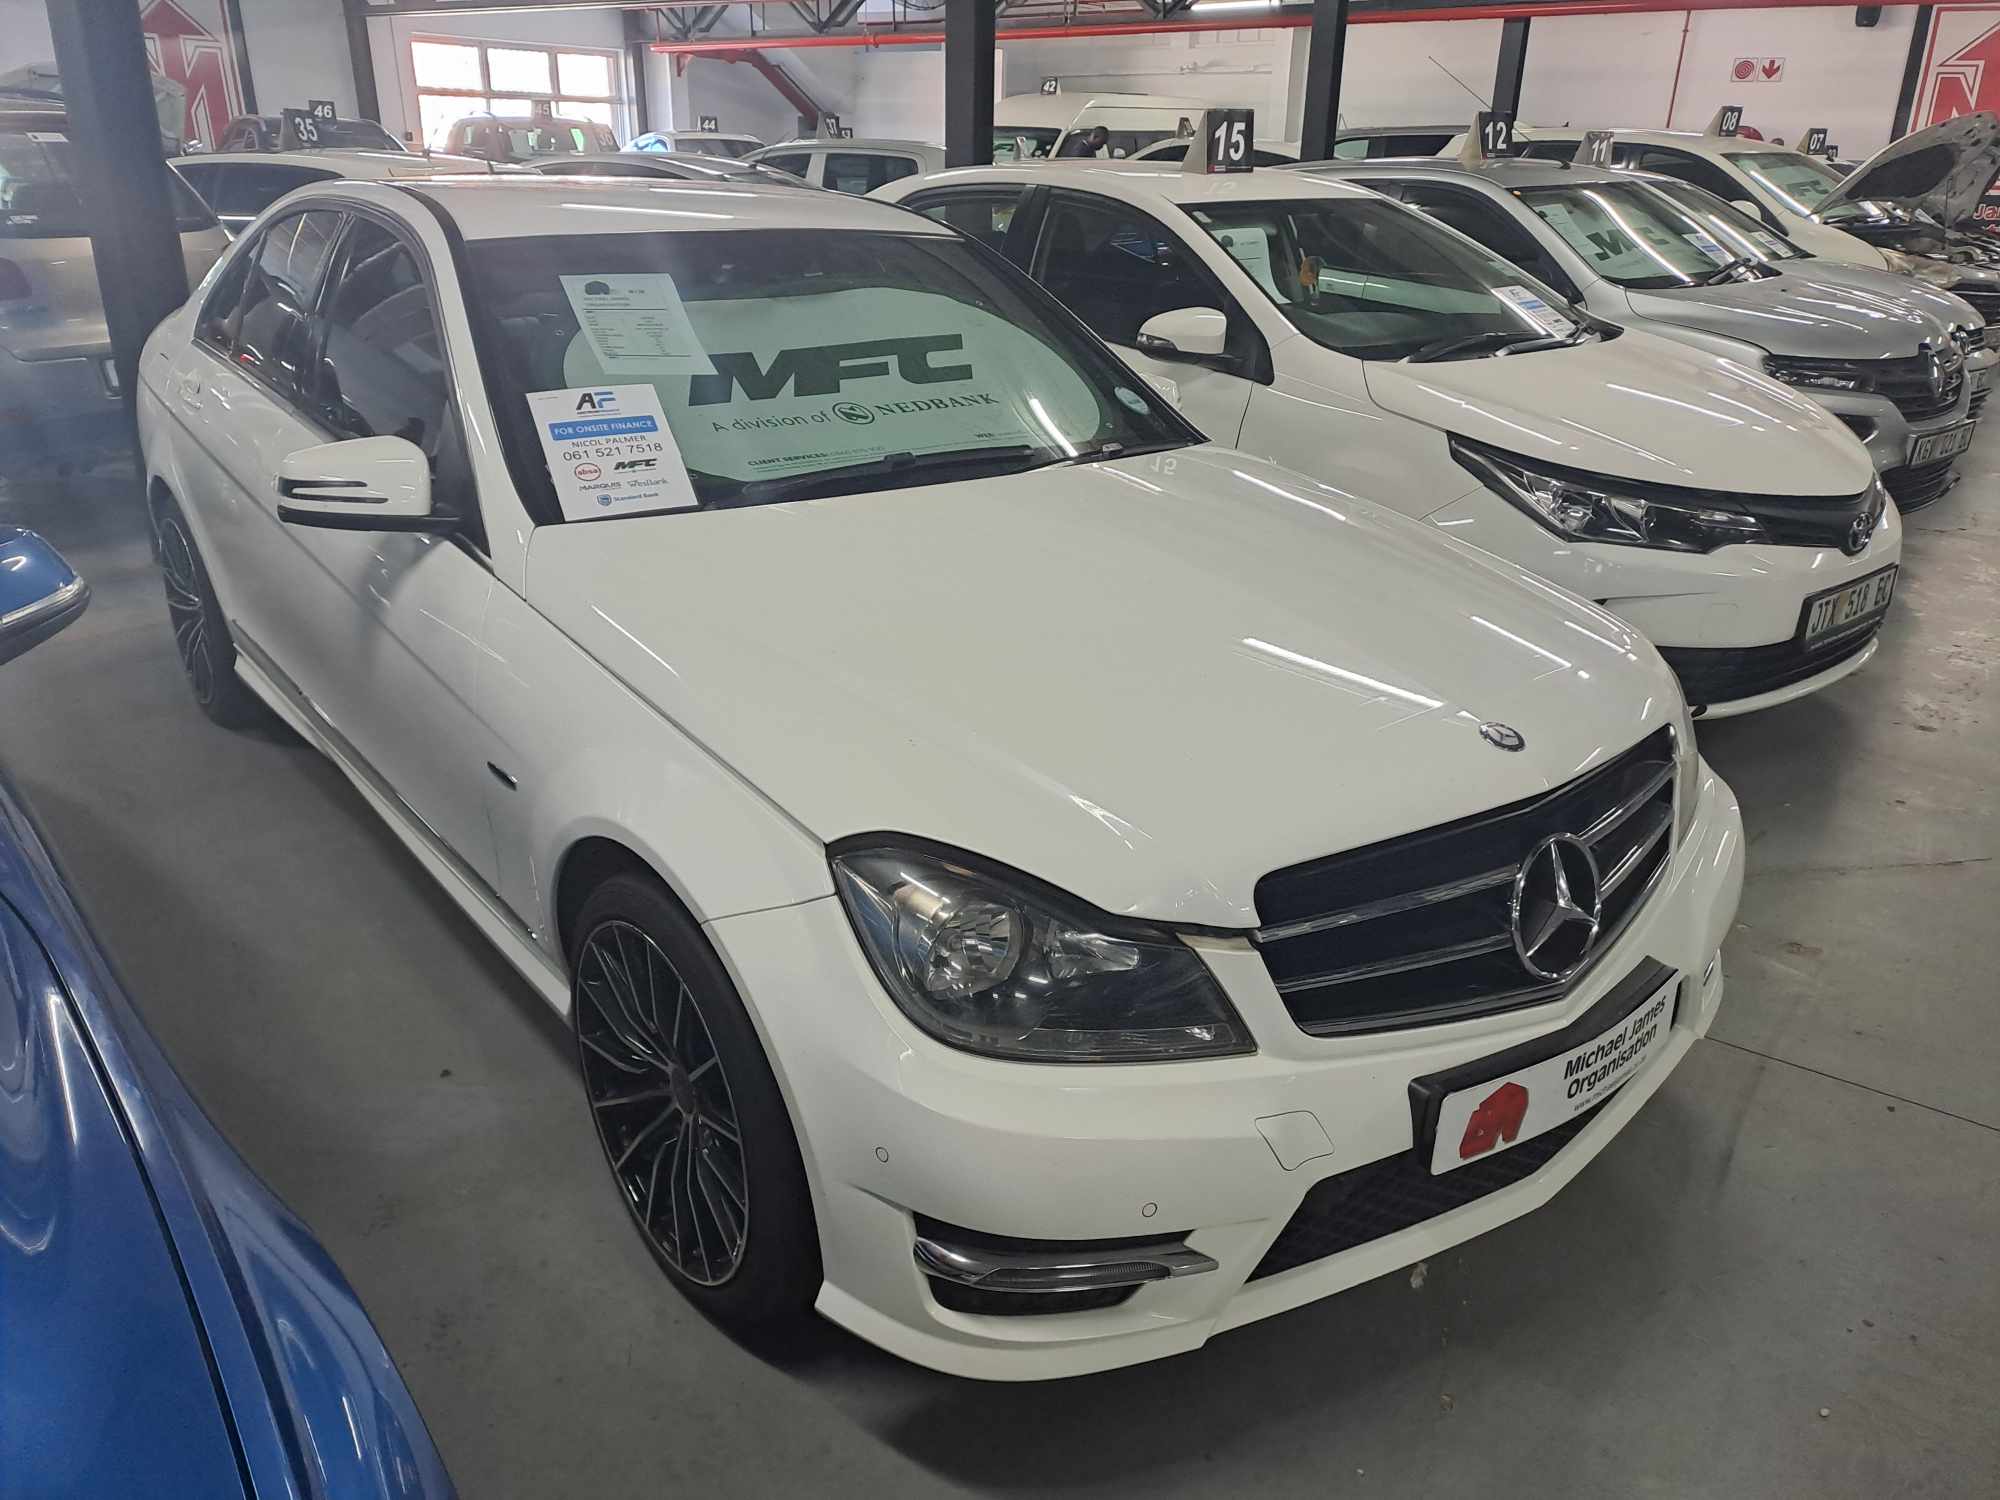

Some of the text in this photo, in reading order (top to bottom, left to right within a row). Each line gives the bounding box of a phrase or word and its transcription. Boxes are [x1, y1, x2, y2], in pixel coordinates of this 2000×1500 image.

[1043, 80, 1057, 93] 42
[313, 105, 333, 119] 46
[1722, 111, 1739, 131] 08
[294, 117, 318, 142] 35
[702, 119, 716, 130] 44
[1214, 119, 1247, 162] 15
[1484, 121, 1507, 150] 12
[1809, 132, 1825, 151] 07
[1591, 138, 1609, 163] 11
[688, 333, 974, 408] MFC
[575, 391, 617, 411] AF
[873, 392, 1000, 417] NEDBANK
[553, 418, 654, 436] FOR ONSITE FINANCE
[711, 410, 834, 433] A division of
[571, 434, 648, 448] NICOL PALMER
[562, 442, 664, 462] 061 521 7518
[747, 455, 781, 467] CLIENT
[613, 458, 658, 471] MFC
[579, 480, 623, 491] MARQUIS
[1811, 598, 1840, 633] JTX
[1844, 583, 1871, 620] 518
[1563, 995, 1667, 1080] Michael James
[1566, 1022, 1658, 1100] Organisation
